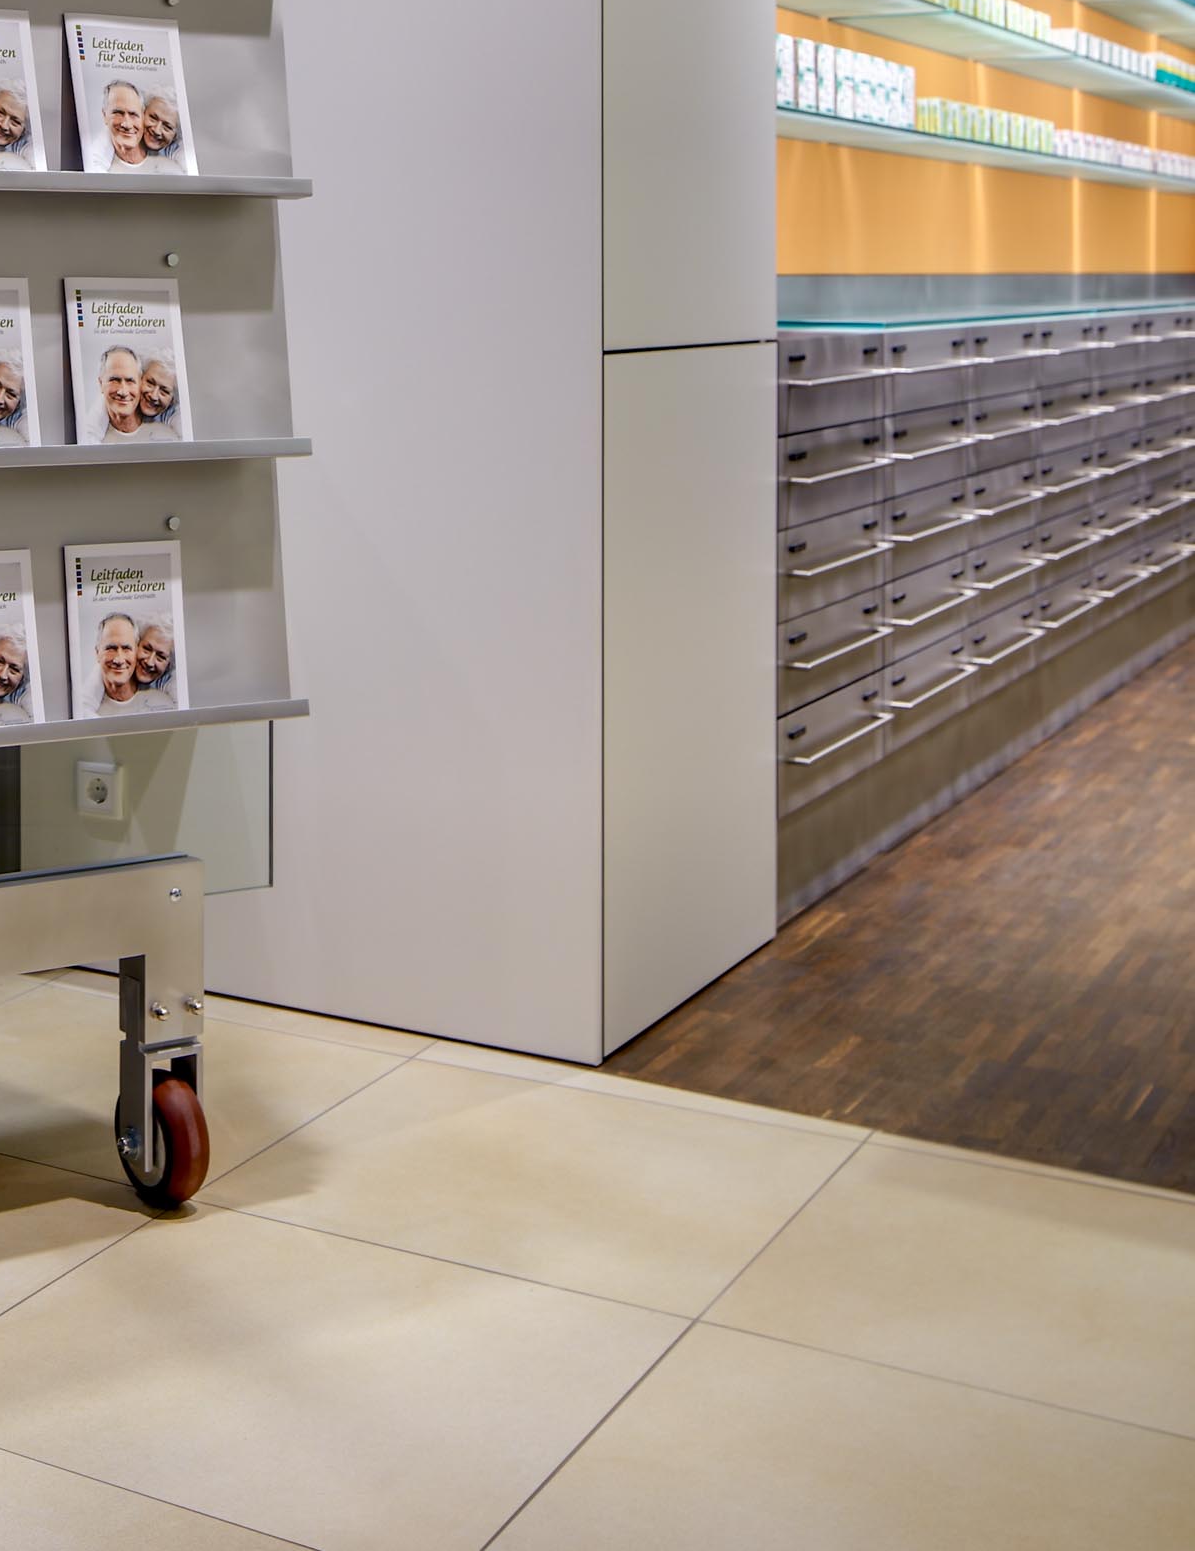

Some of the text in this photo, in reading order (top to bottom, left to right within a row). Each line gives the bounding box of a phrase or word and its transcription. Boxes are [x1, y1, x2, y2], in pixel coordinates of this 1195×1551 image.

[92, 36, 144, 52] Leitfaden
[98, 50, 167, 66] für Senioren
[91, 301, 144, 316] Leitfaden
[97, 315, 166, 329] für Senioren
[90, 567, 144, 583] Leitfaden
[95, 579, 166, 597] für Senioren
